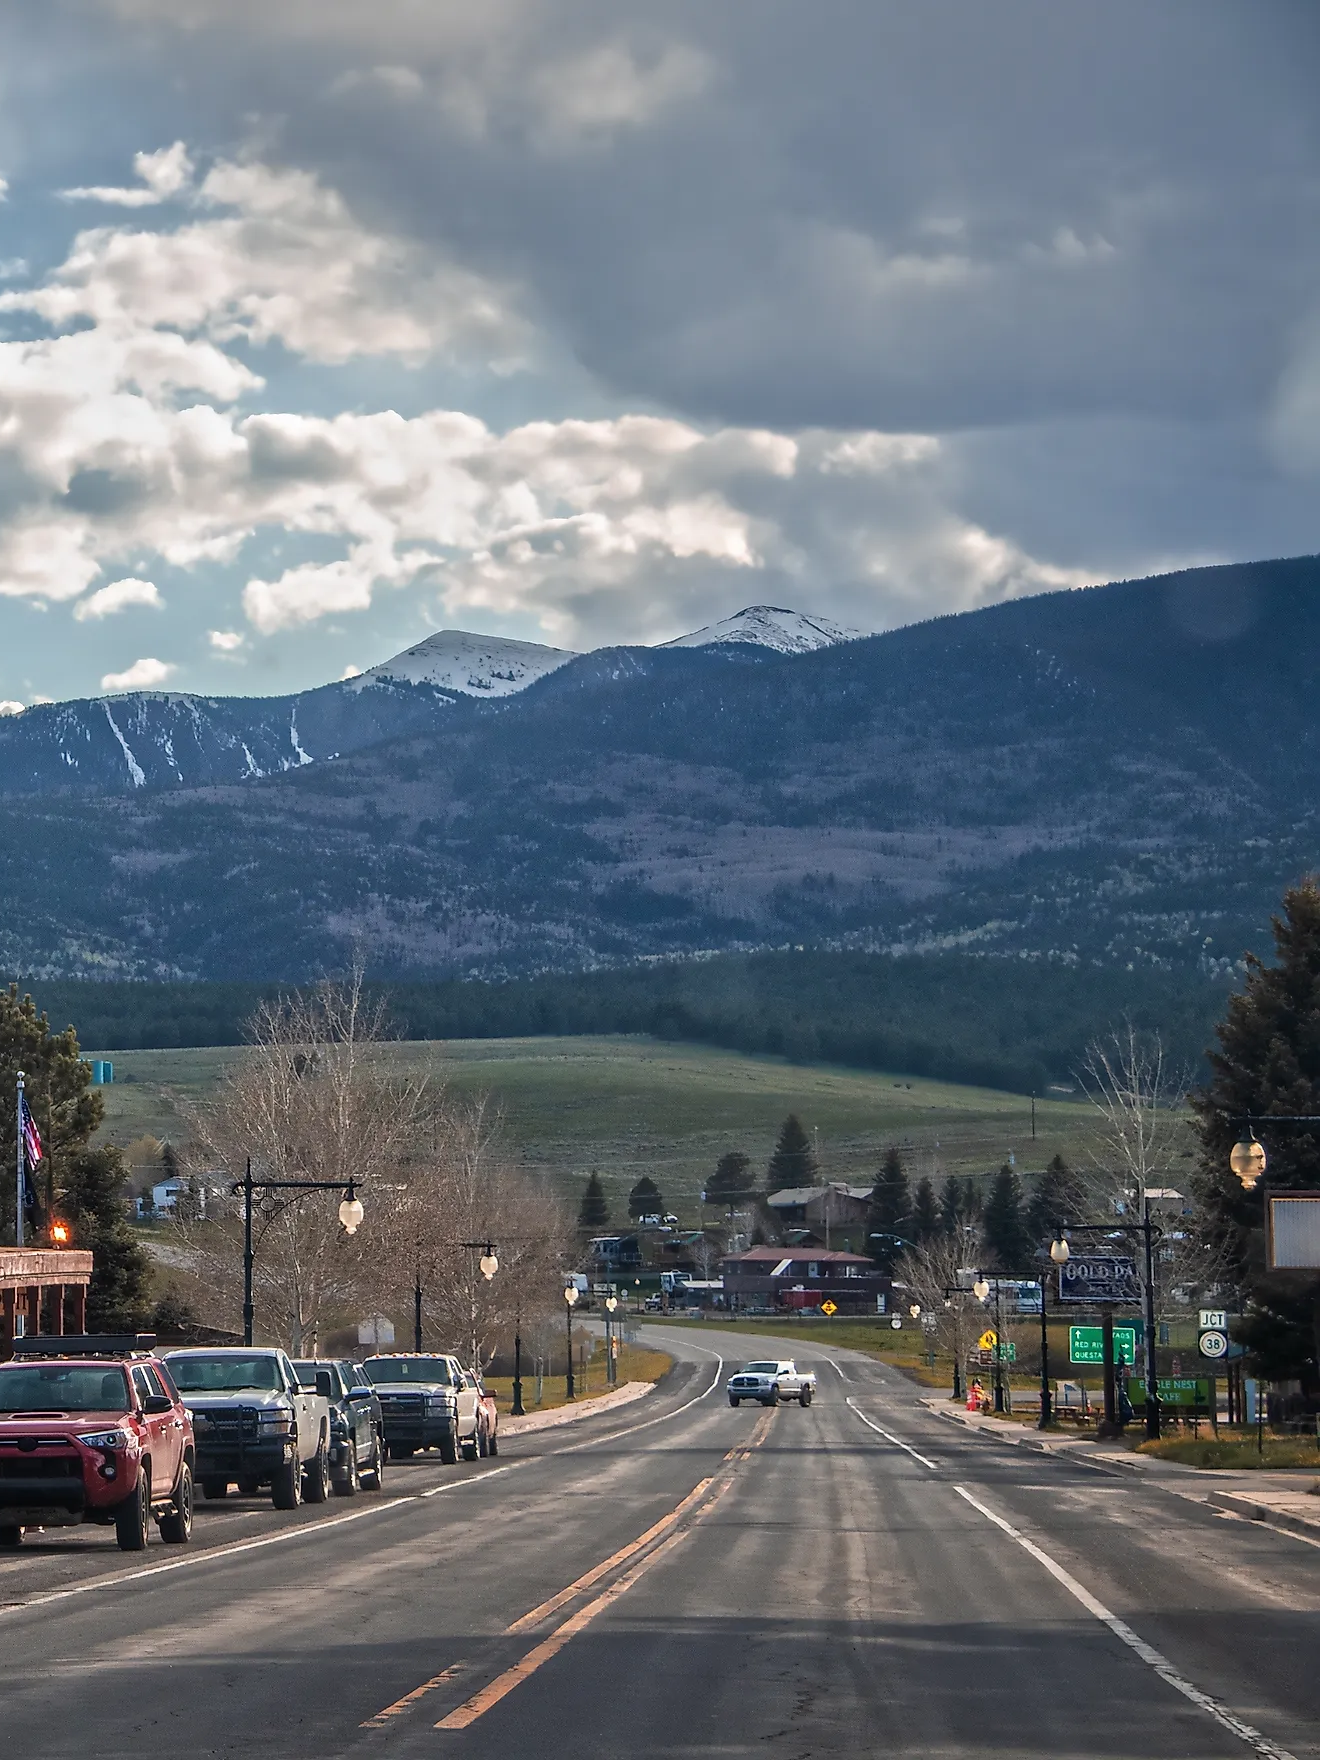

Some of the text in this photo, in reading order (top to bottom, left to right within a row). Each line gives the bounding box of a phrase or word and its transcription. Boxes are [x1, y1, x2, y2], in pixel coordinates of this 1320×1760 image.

[1066, 1263, 1109, 1280] GOLD
[1202, 1313, 1223, 1326] JCT
[1206, 1338, 1220, 1350] 38
[1075, 1351, 1103, 1359] QUESTA
[1174, 1380, 1197, 1389] NEST
